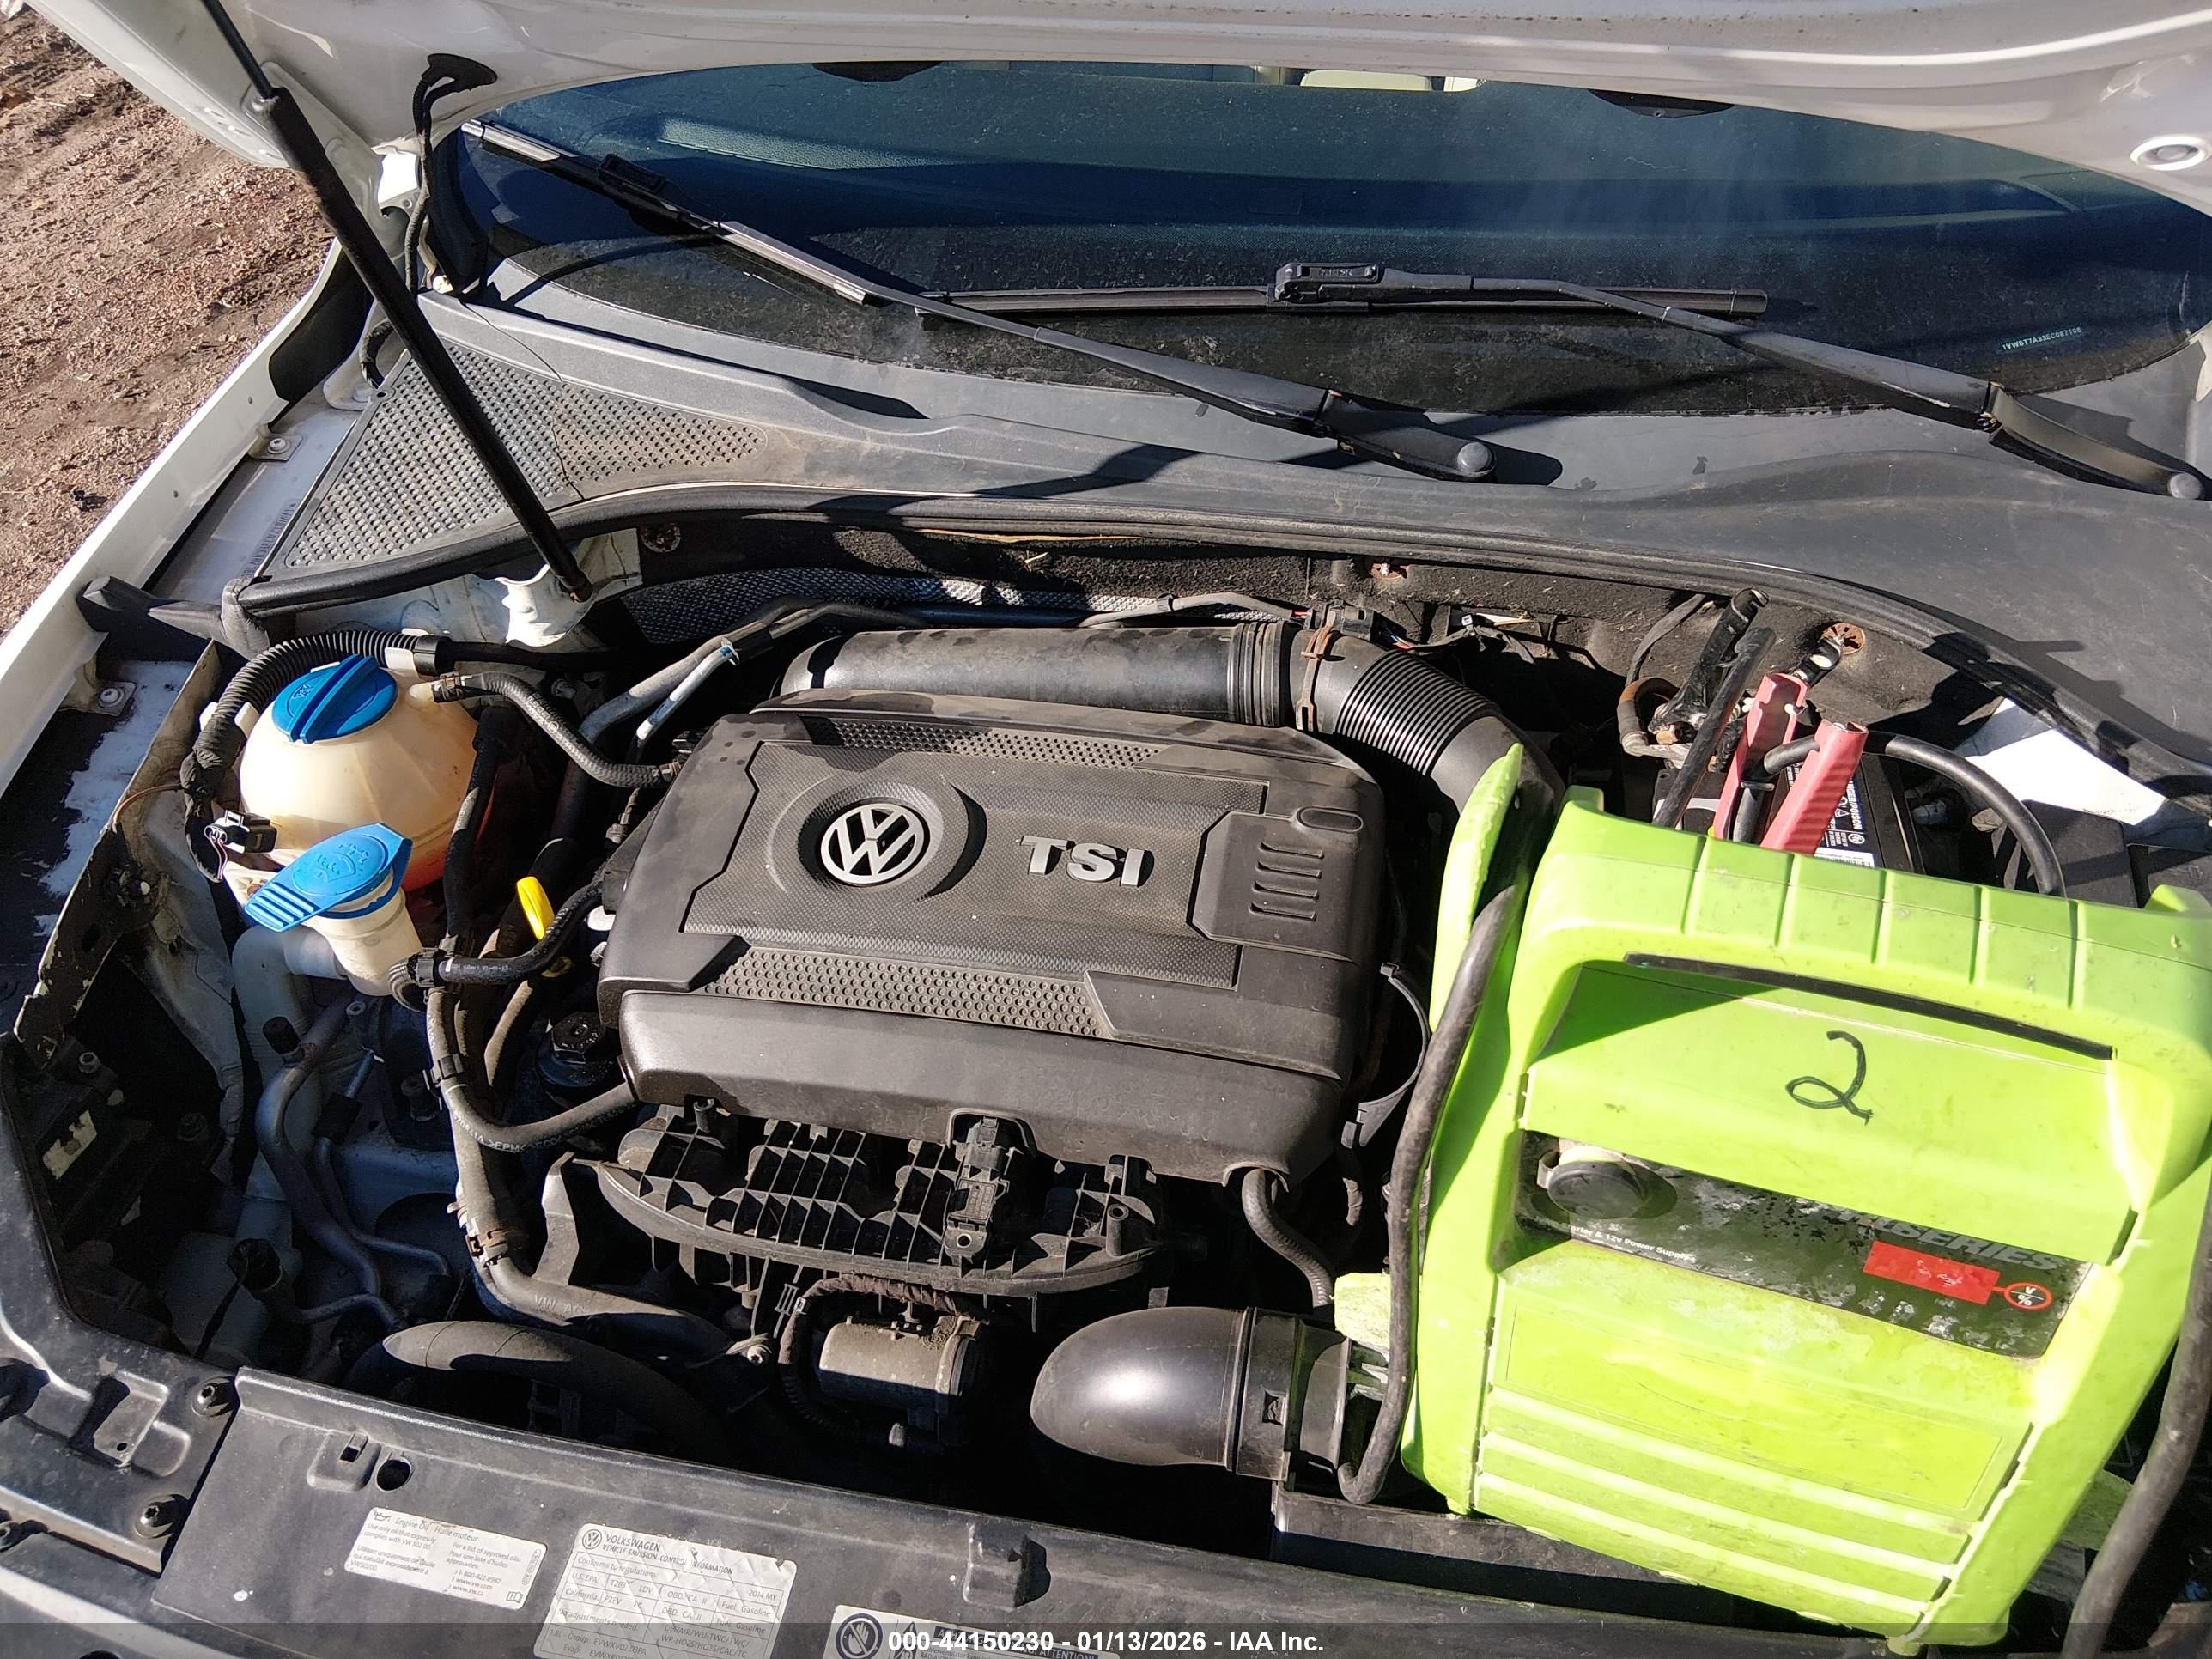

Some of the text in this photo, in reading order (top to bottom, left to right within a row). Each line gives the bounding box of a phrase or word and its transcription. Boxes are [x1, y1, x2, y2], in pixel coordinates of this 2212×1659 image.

[1020, 836, 1145, 887] TSI
[1785, 1030, 1874, 1126] 2
[1606, 1233, 1622, 1243] 12v
[1624, 1237, 1655, 1252] Power
[2025, 1285, 2036, 1295] V
[395, 1517, 418, 1528] Engine
[434, 1526, 453, 1535] Huile
[453, 1531, 478, 1542] moteur
[605, 1534, 661, 1553] VOLKSWAGEN
[603, 1544, 626, 1554] VEHICLE
[628, 1549, 658, 1560] EMISSION
[578, 1556, 609, 1569] Conforms
[611, 1562, 618, 1571] to
[611, 1579, 626, 1589] T2B3
[638, 1584, 653, 1594] LDV
[687, 1594, 697, 1603] CA
[749, 1589, 763, 1598] 2014
[568, 1612, 611, 1626] adjustments
[682, 1611, 692, 1620] CA
[741, 1606, 771, 1618] Gasoline
[736, 1621, 766, 1635] Gasoline
